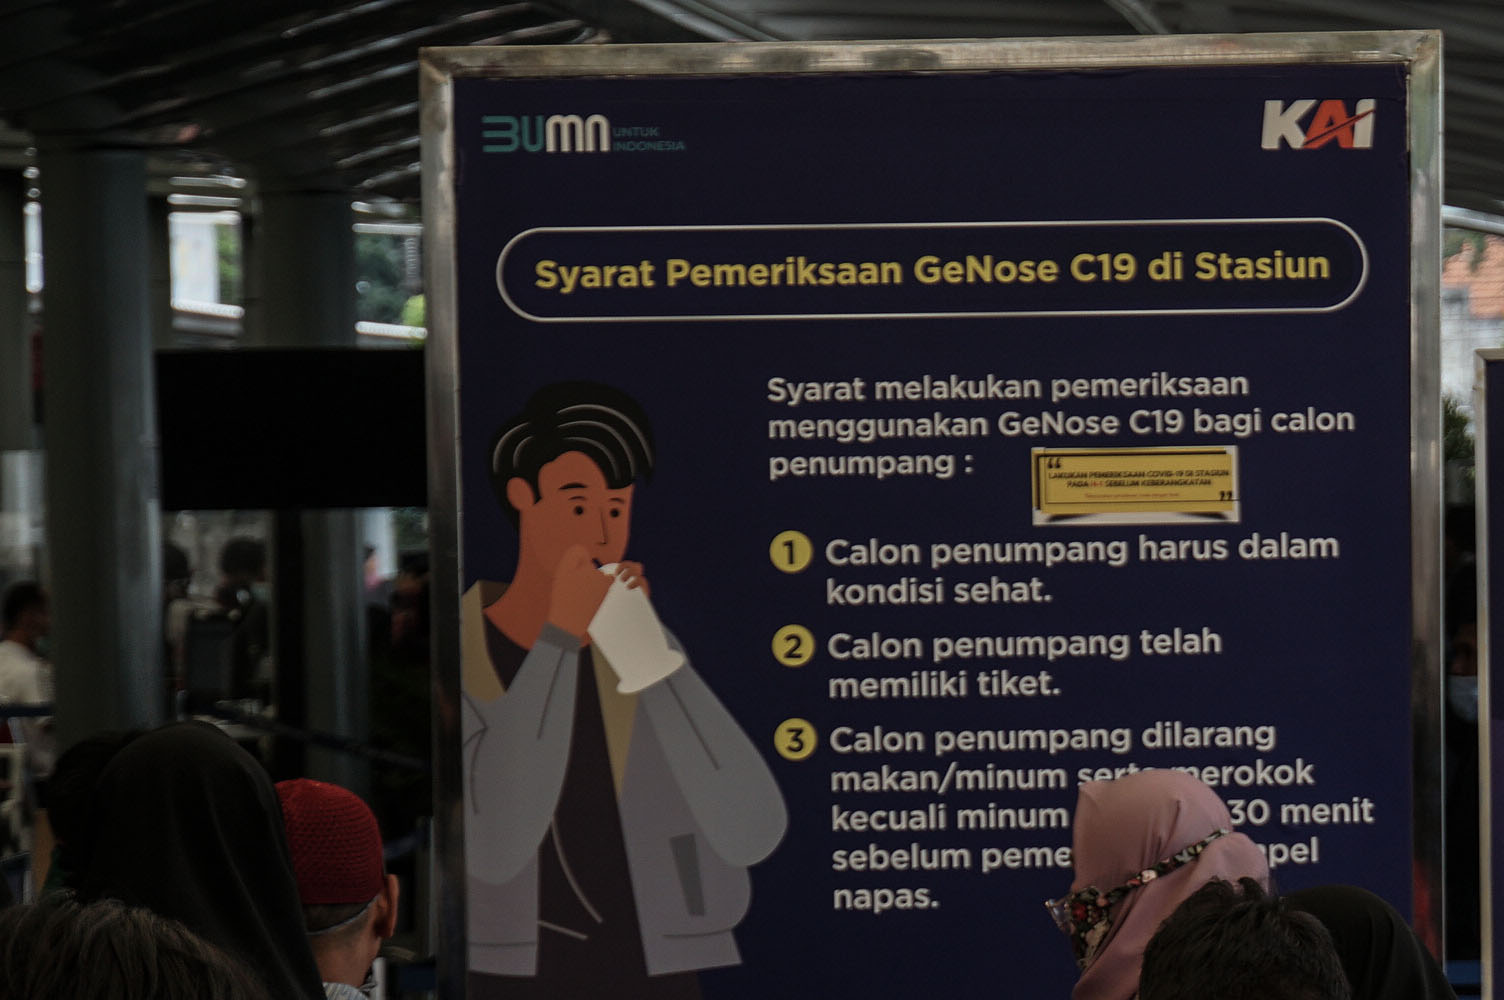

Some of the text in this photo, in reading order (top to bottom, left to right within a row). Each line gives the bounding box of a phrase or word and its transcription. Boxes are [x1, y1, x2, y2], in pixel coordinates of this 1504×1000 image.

[613, 127, 659, 137] UNTUK
[1261, 98, 1376, 149] KAI
[613, 141, 685, 151] INDONESIA
[535, 249, 1330, 294] Syarat Pemeriksaan GeNose C19 di Stasiun
[767, 371, 1249, 406] Syarat melakukan pemeriksaan
[768, 406, 1355, 443] menggunakan GeNose C19 bagi calon
[769, 454, 955, 481] penumpang
[780, 531, 1339, 569] 1 Calon penumpang harus dalam
[826, 575, 1052, 605] kondisi sehat.
[782, 626, 1222, 663] 2 Calon penumpang telah
[829, 669, 1060, 699] memiliki tiket.
[784, 720, 1276, 756] 3 Calon penumpang dilarang
[831, 761, 1067, 794] makan/minum
[1077, 763, 1155, 786] sert
[831, 796, 1374, 831] kecuali minum 30 menit
[832, 836, 1320, 873] sebelum peme pel
[833, 887, 939, 914] napas.
